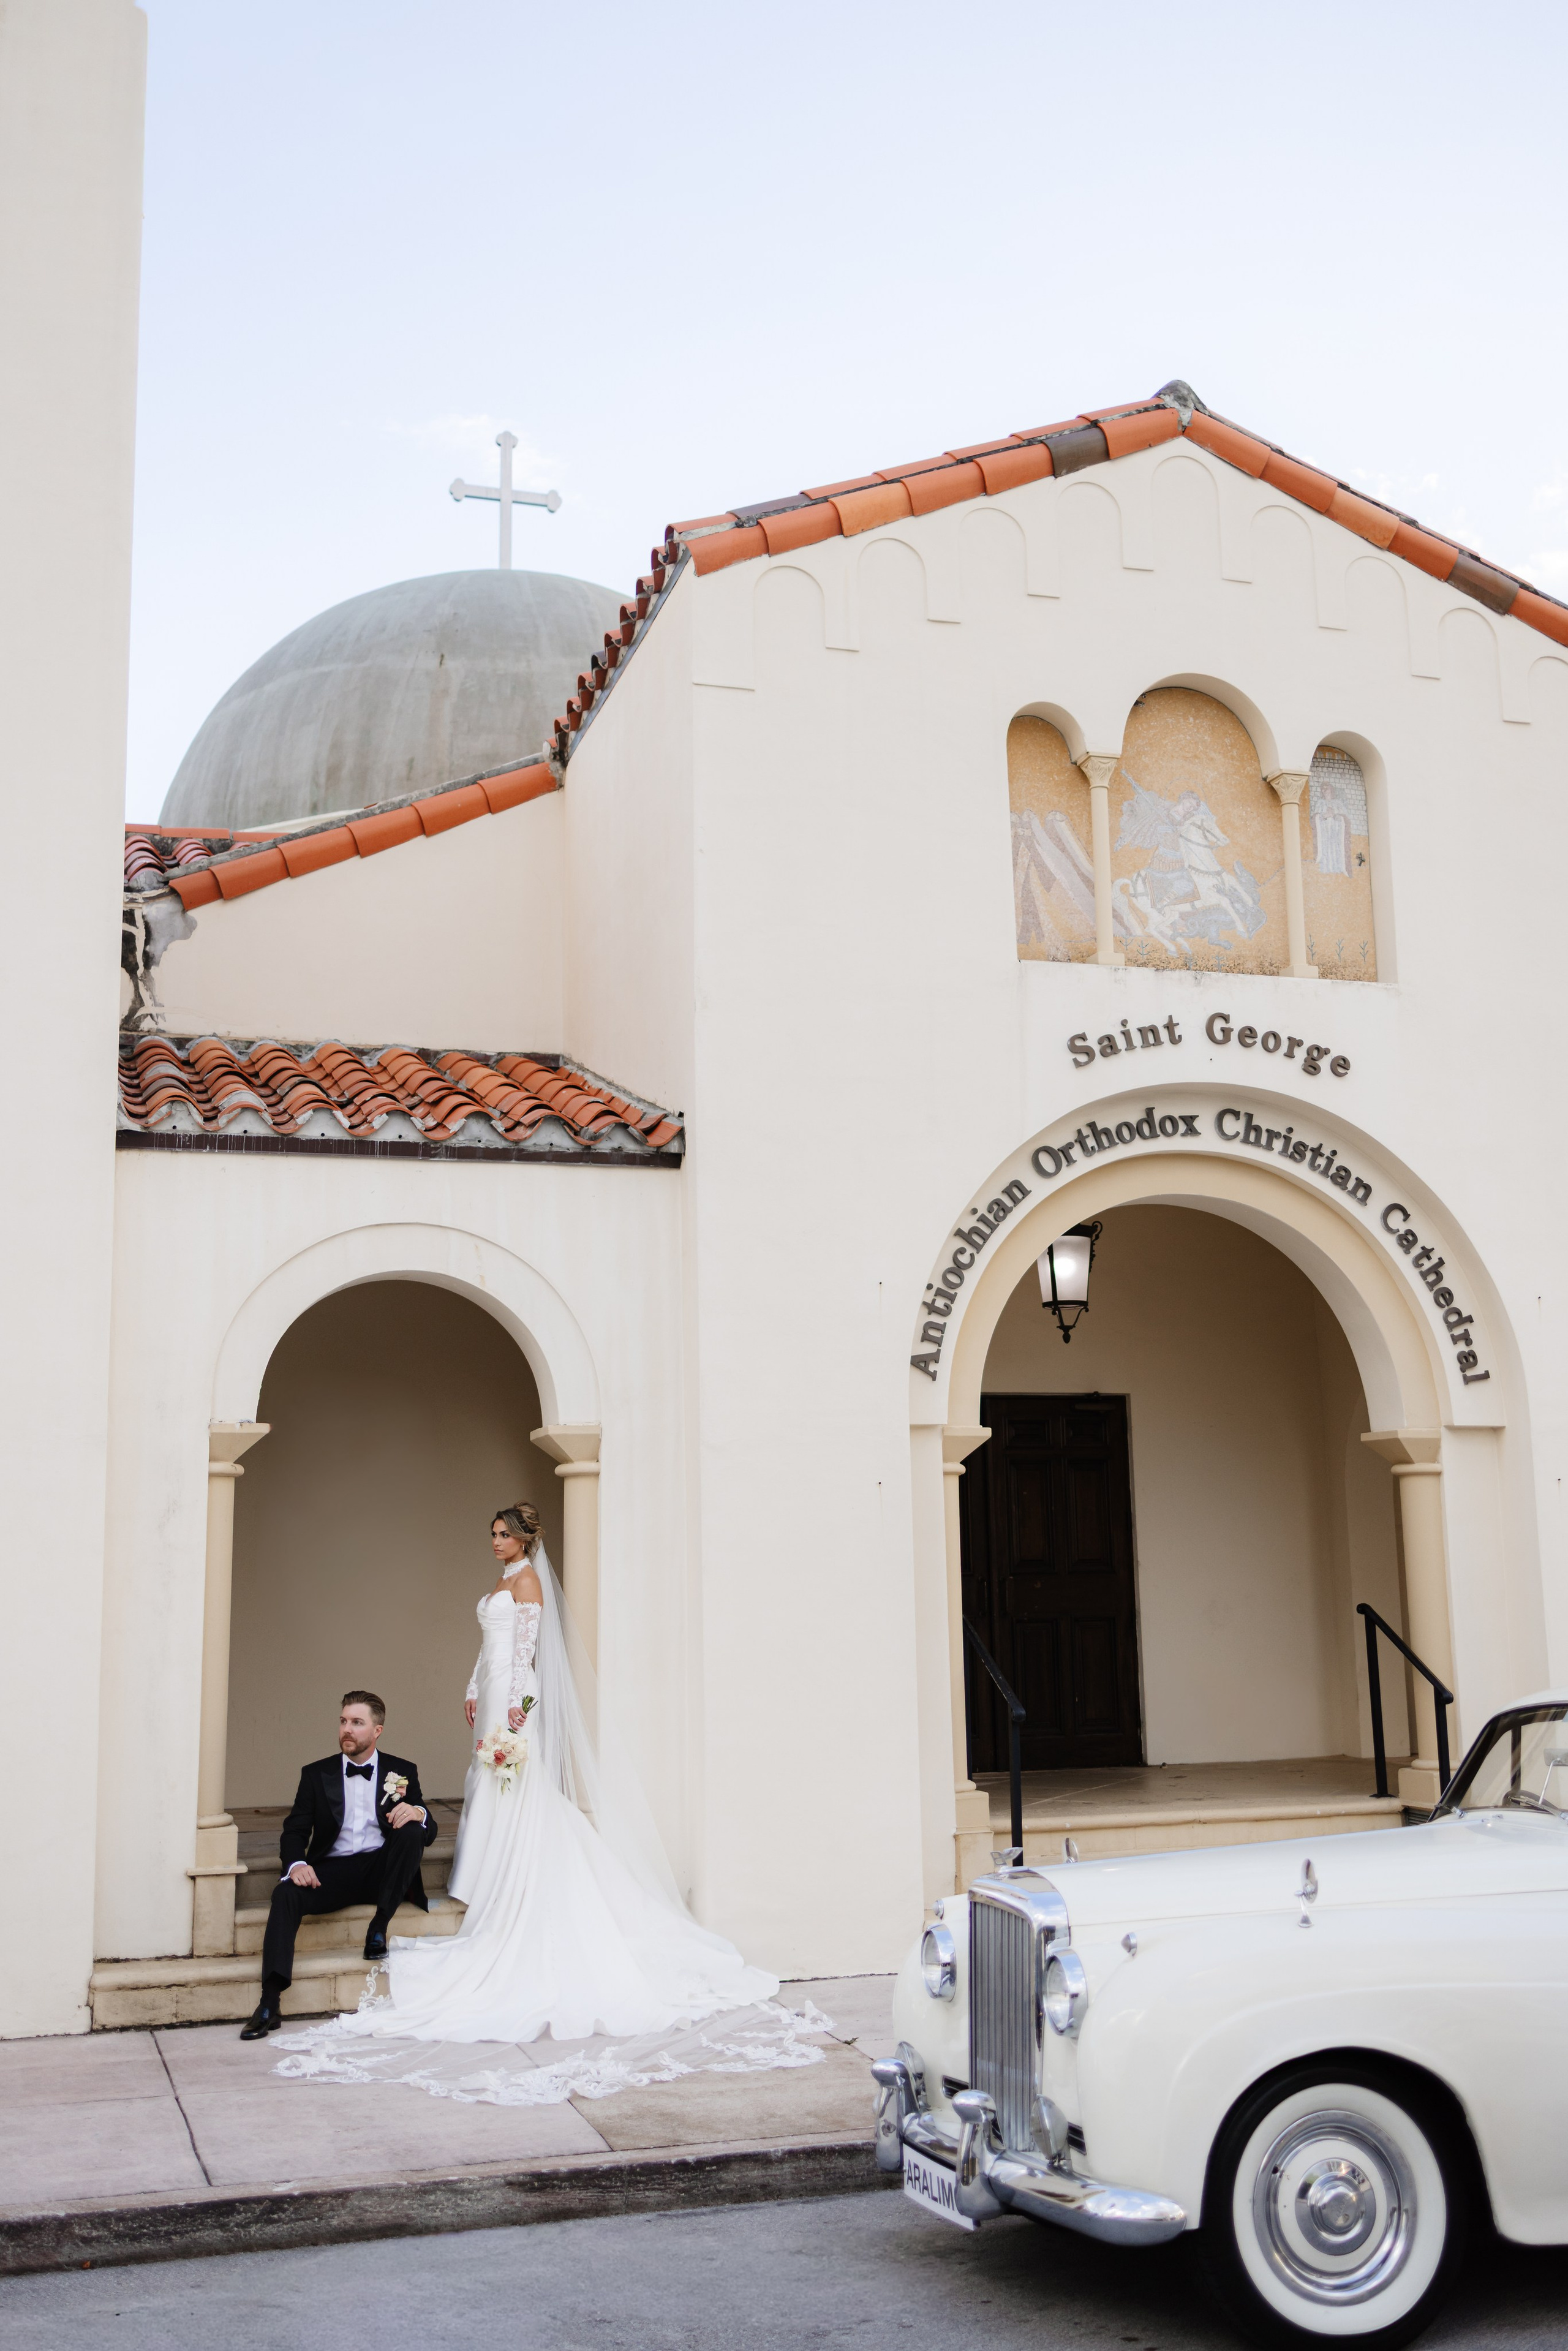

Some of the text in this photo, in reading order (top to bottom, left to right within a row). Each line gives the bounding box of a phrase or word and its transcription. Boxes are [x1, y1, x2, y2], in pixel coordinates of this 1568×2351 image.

[1067, 1012, 1351, 1077] Saint George
[910, 1106, 1491, 1386] Antiochian Orthodox Christian Cathedral
[907, 2159, 956, 2211] ARALIM
